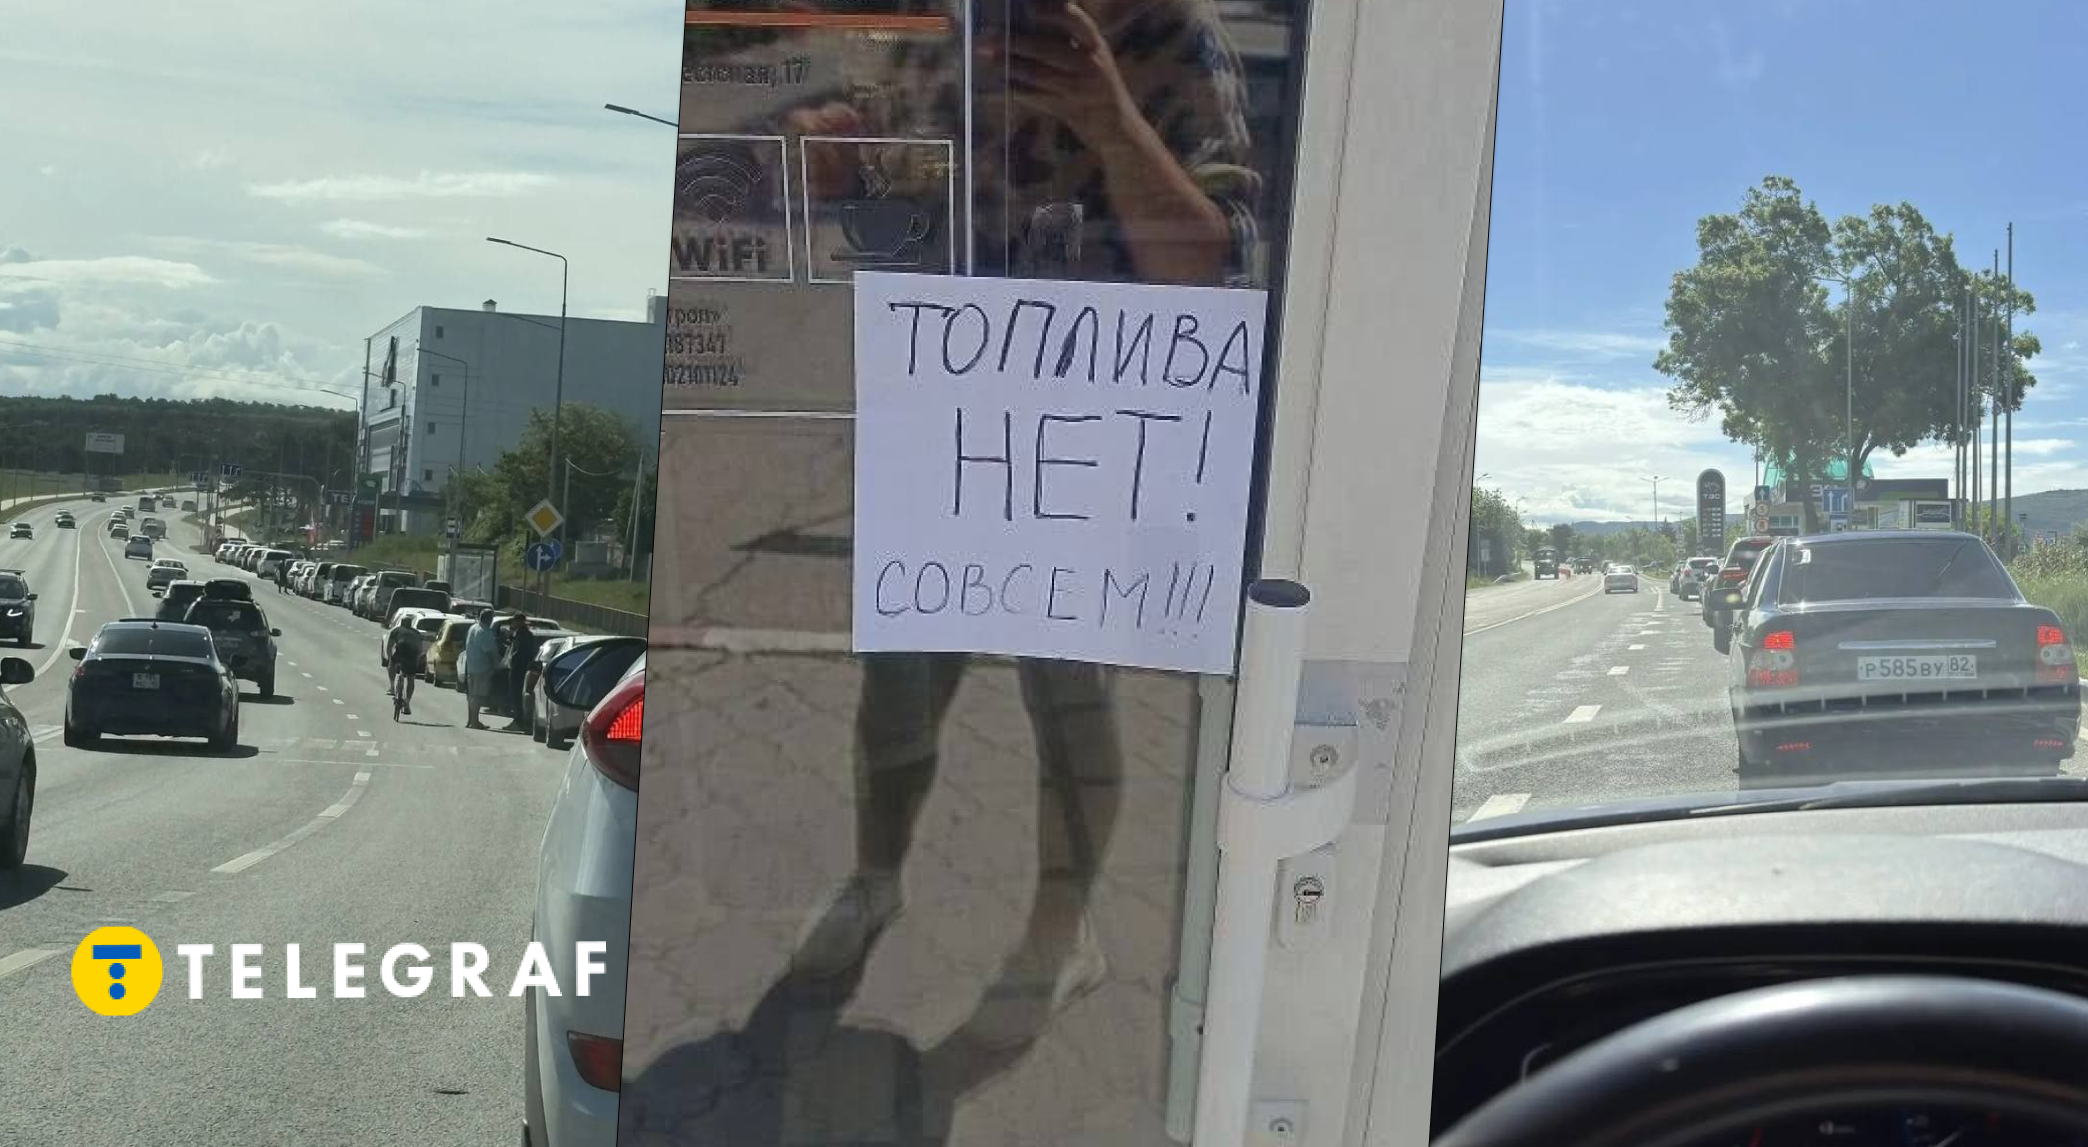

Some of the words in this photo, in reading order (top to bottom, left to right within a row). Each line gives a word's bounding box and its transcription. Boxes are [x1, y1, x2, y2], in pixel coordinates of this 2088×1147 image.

[672, 236, 766, 273] WiFi
[889, 298, 1250, 394] ТОПЛИВА
[952, 406, 1212, 522] НЕТ!
[875, 560, 1215, 640] СОВСЕМ!!!
